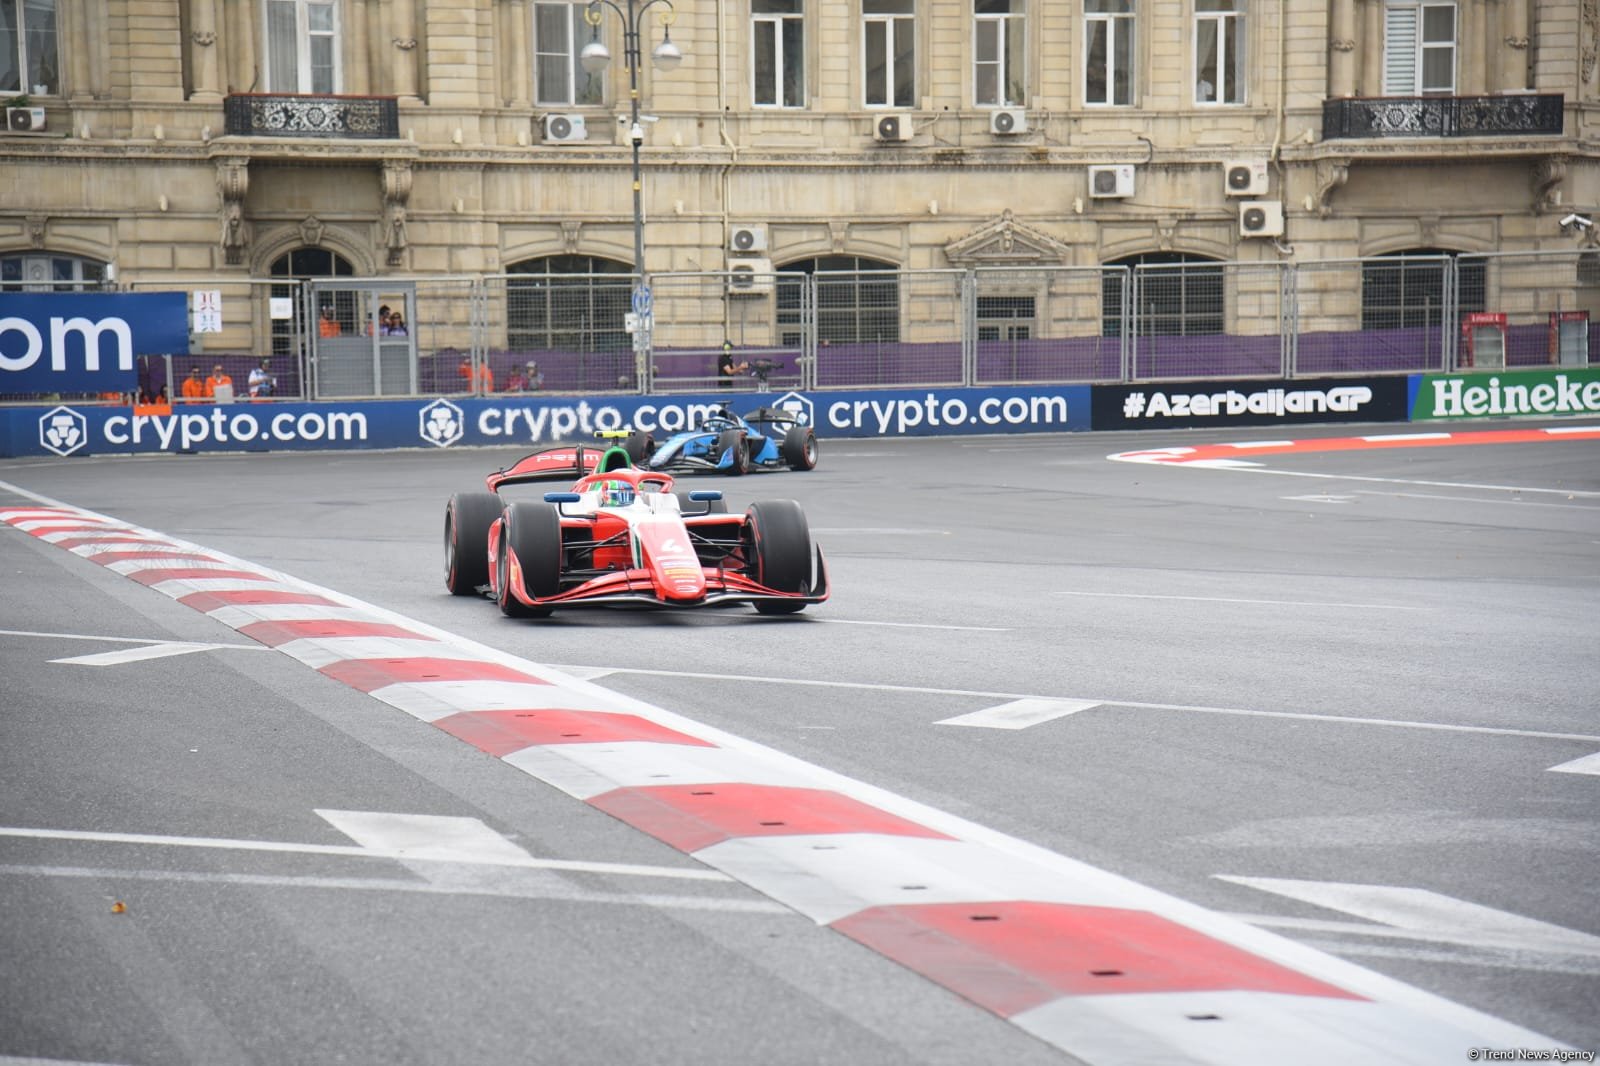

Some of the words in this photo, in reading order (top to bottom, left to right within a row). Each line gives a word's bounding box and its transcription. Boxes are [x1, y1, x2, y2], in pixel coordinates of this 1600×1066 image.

[0, 316, 133, 371] om
[828, 393, 1067, 433] crypto.com
[1432, 374, 1600, 417] Heineke
[103, 407, 367, 450] crypto.com
[478, 401, 723, 442] crypto.com
[661, 538, 684, 553] 4
